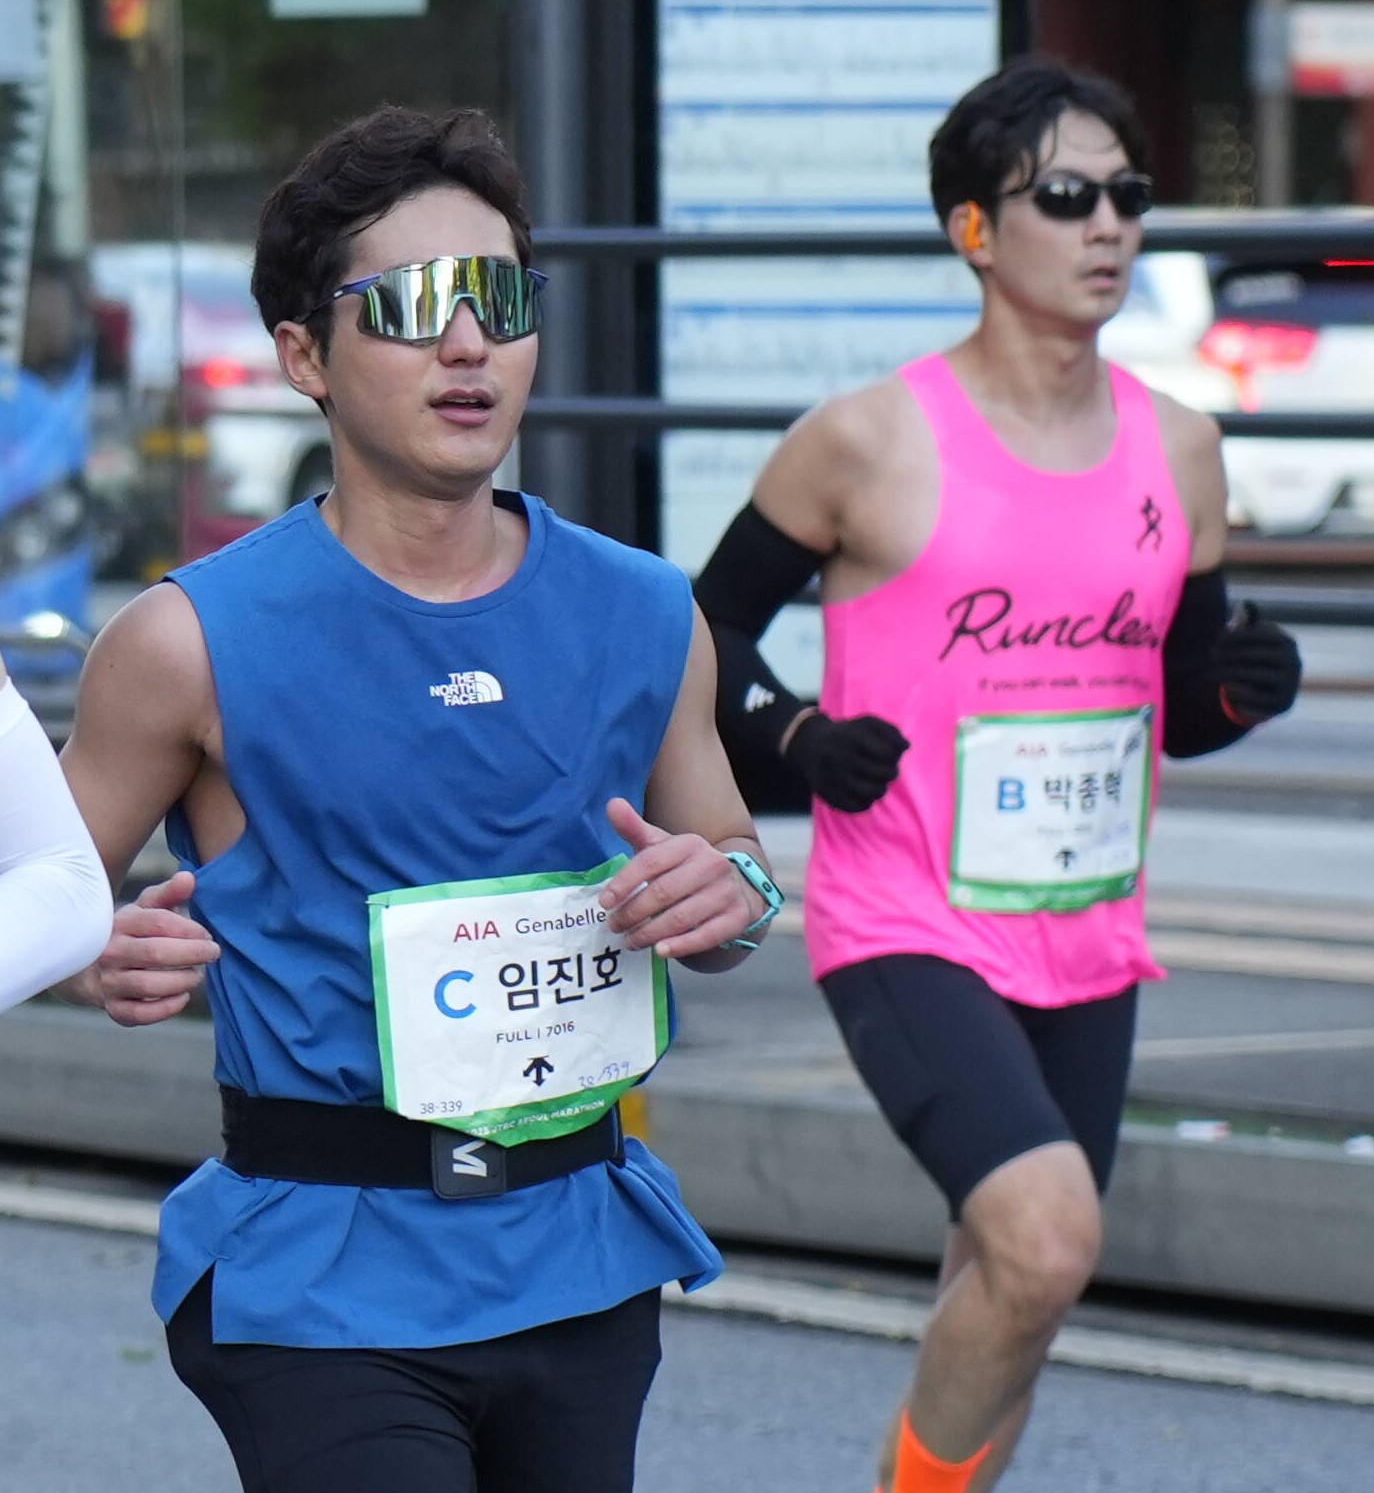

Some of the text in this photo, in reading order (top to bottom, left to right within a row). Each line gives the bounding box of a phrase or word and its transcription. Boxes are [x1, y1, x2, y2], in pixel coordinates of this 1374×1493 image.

[448, 671, 475, 685] THE
[429, 682, 477, 697] NORTH
[444, 693, 479, 707] FACE
[998, 778, 1025, 810] B
[453, 909, 607, 943] AIA Genabelle
[433, 945, 623, 1020] C 임진호
[496, 1029, 533, 1044] FULL
[546, 1020, 575, 1038] 7016
[419, 1099, 463, 1115] 38-339
[551, 1099, 606, 1119] MARATHON
